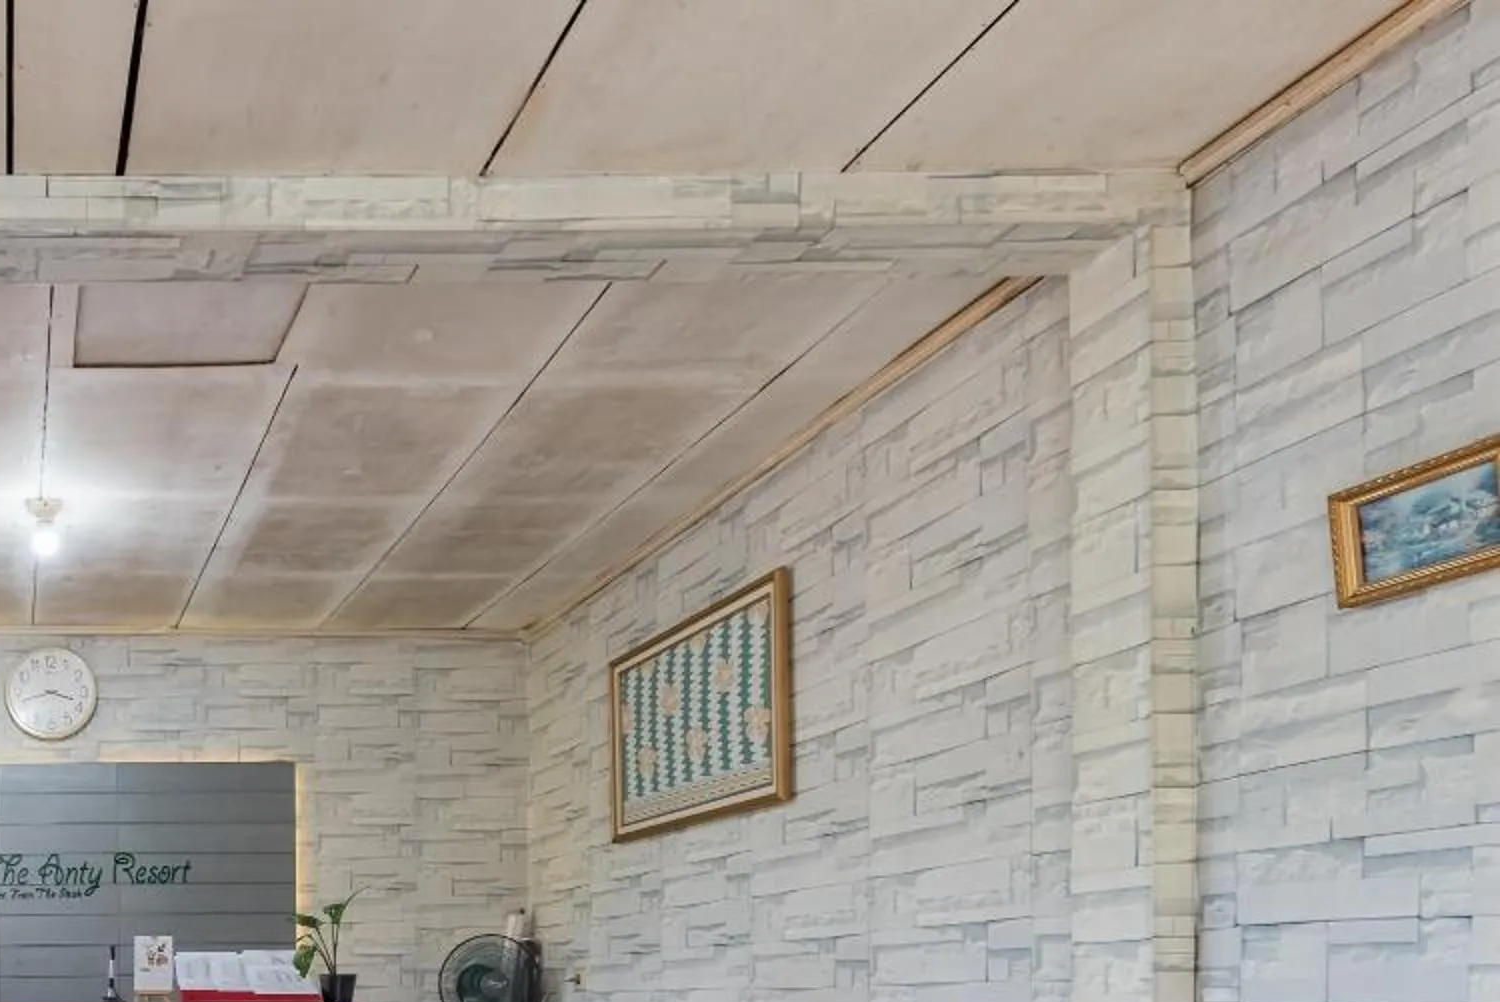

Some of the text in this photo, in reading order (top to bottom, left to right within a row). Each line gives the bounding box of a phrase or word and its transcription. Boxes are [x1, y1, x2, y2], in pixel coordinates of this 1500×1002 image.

[44, 654, 57, 669] 12
[37, 853, 103, 896] Anty
[113, 851, 193, 885] Resort
